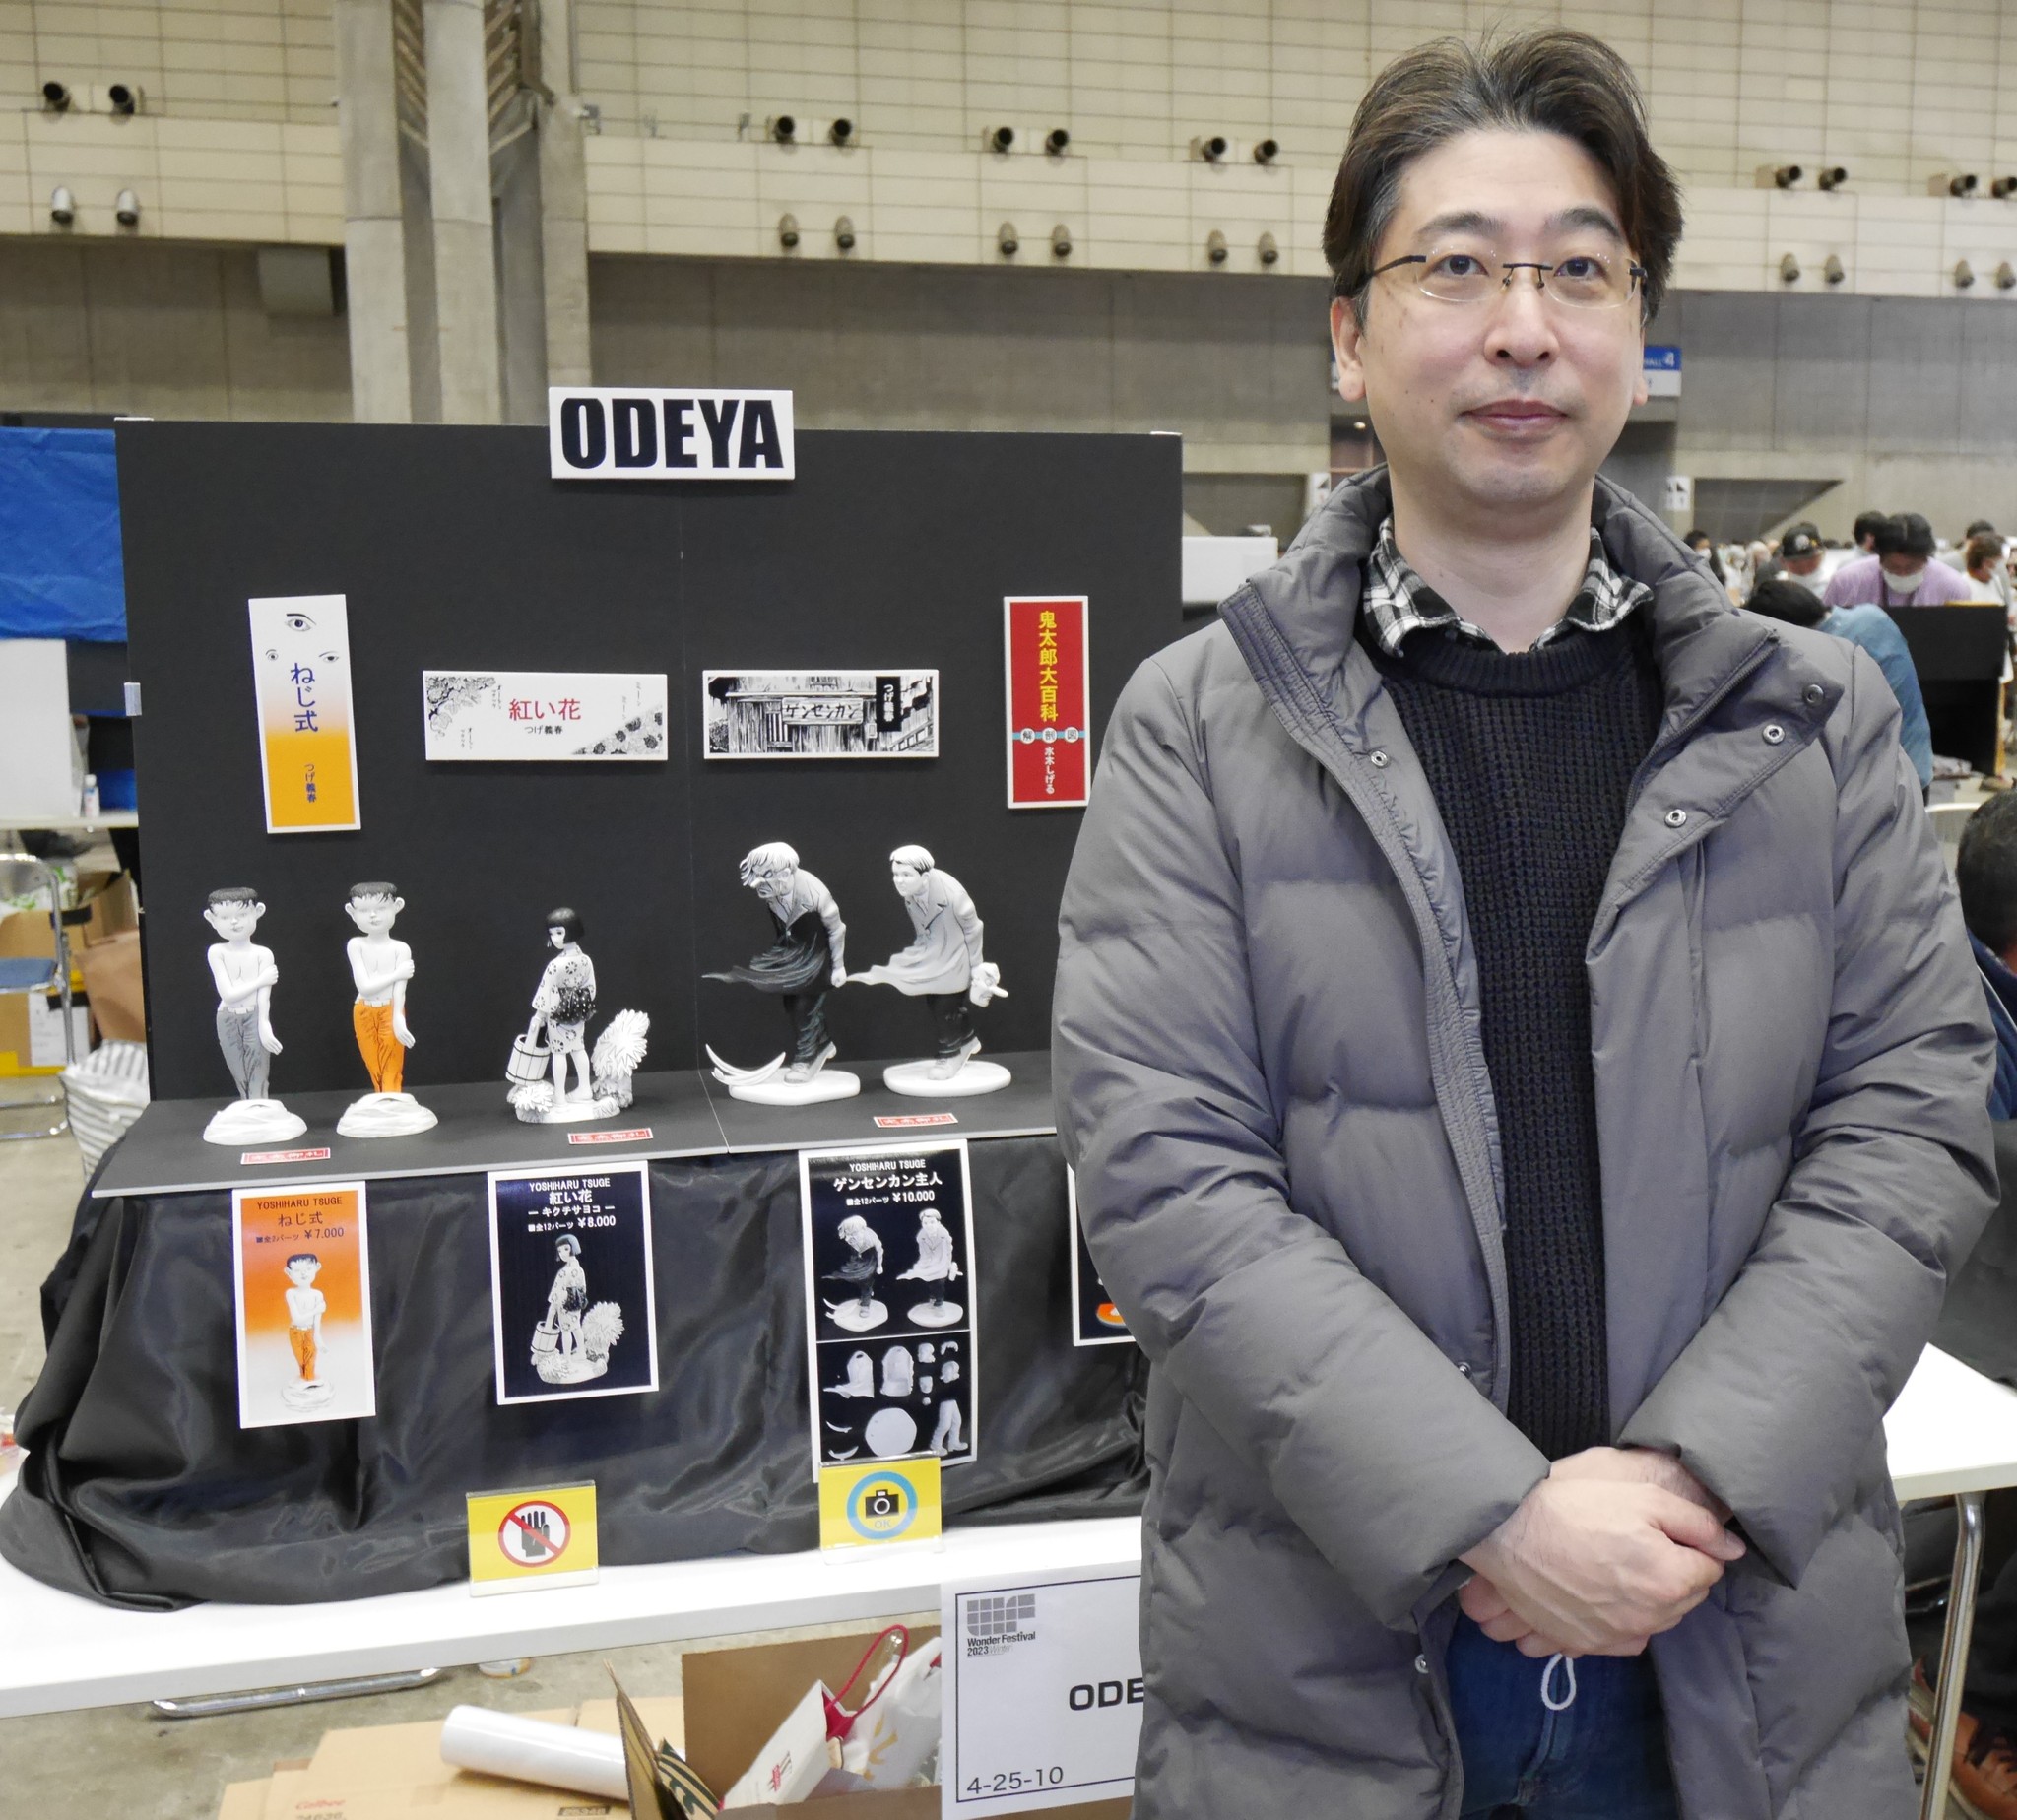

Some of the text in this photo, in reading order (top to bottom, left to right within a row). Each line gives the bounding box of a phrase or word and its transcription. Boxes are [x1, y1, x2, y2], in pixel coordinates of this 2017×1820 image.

[560, 397, 785, 470] ODEYA
[1038, 610, 1059, 722] 鬼太郎大百科
[290, 662, 319, 733] ねじ式
[508, 698, 582, 721] 紅い花
[786, 702, 862, 720] ゲンセンカン
[524, 724, 563, 735] つげ義春
[1044, 746, 1056, 795] 水木しげる
[303, 762, 317, 804] つげ義春
[849, 1159, 927, 1173] YOSHIHARU TSUGE
[529, 1177, 612, 1193] YOSHIHARU TSUGE
[833, 1171, 943, 1193] ゲンセンカン主人
[257, 1196, 343, 1211] YOSHIHARU TSUGE
[549, 1188, 594, 1206] 紅い花
[278, 1210, 324, 1228] ねじ式
[967, 1631, 1036, 1648] Wonder Festival
[967, 1646, 989, 1657] 2023
[1069, 1677, 1144, 1711] ODE
[967, 1766, 1064, 1794] 4-25-10
